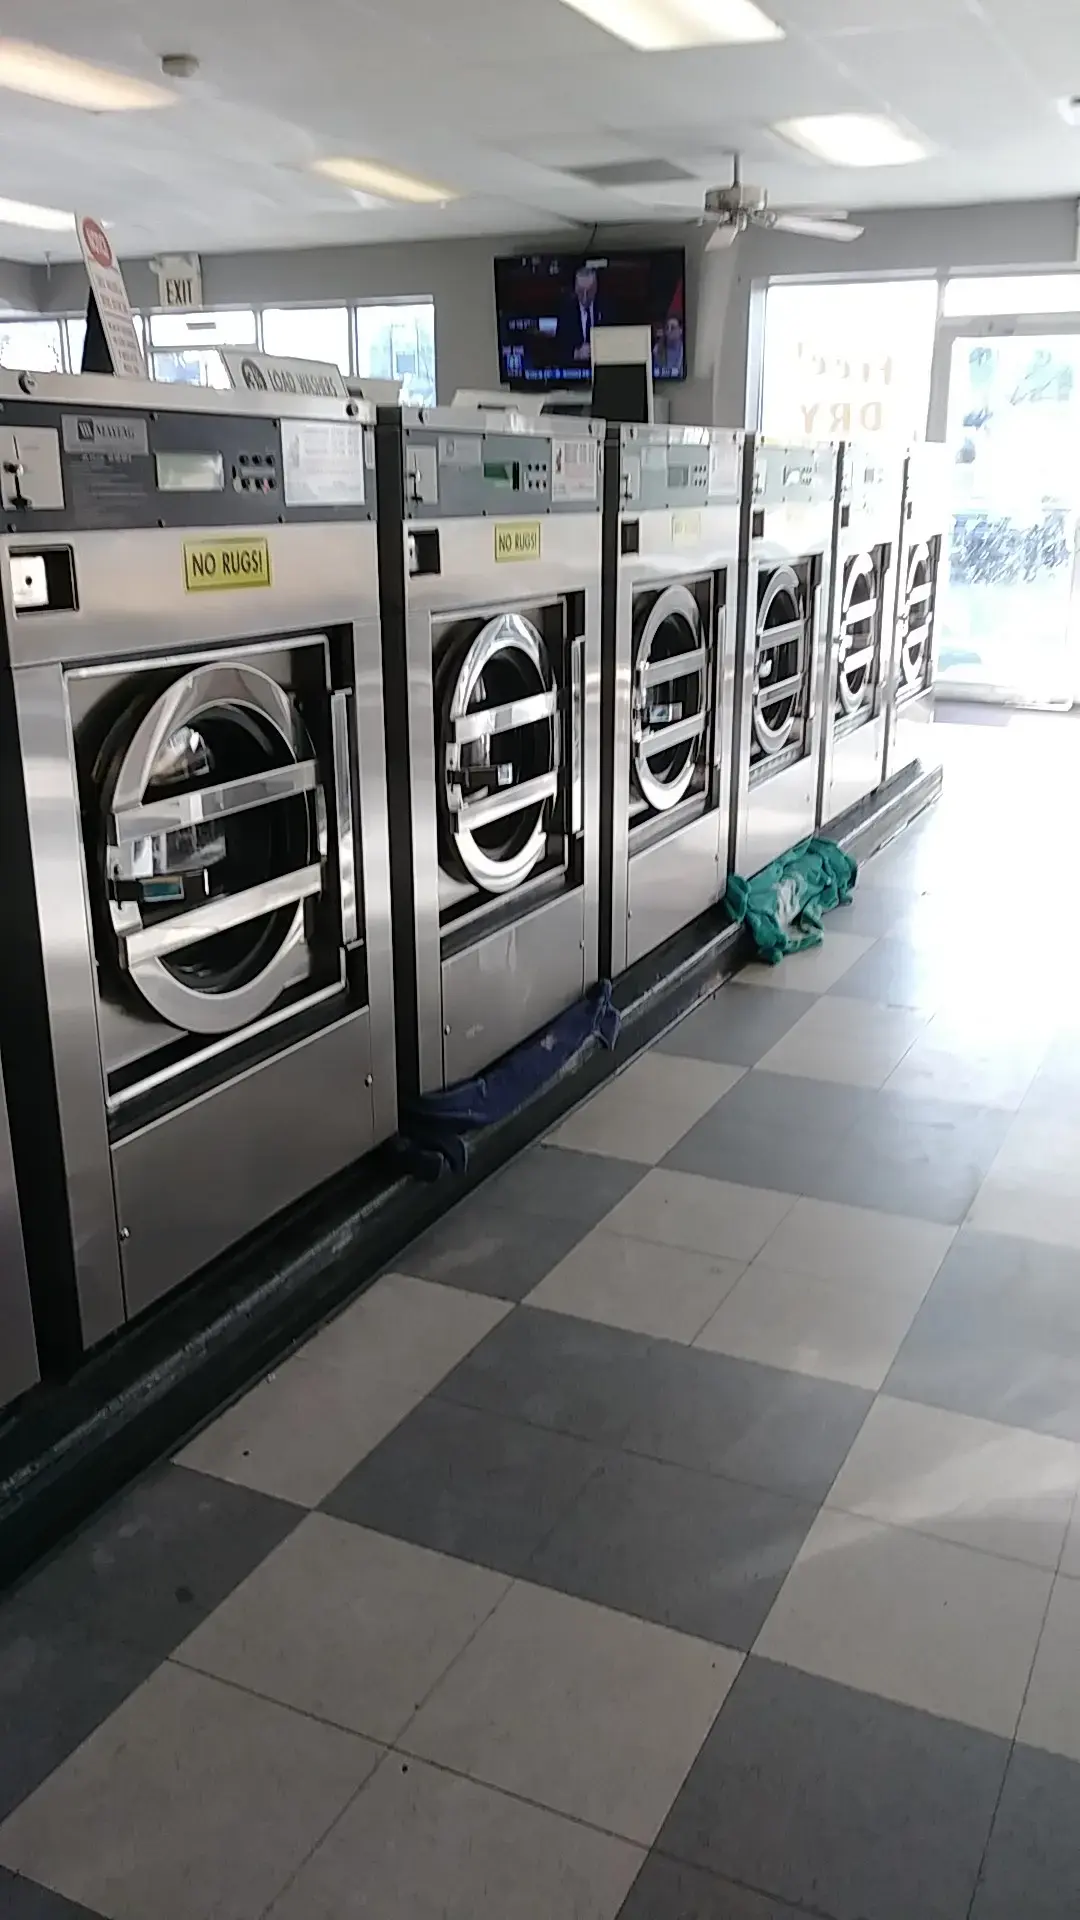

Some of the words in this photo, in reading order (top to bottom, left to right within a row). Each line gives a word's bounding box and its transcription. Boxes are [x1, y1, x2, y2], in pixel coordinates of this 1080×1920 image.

[165, 277, 193, 305] EXIT
[265, 367, 297, 393] LOAD
[296, 372, 338, 398] WASHERS
[498, 531, 512, 552] NO
[515, 531, 537, 552] RUGS!
[192, 551, 216, 577] NO
[222, 549, 263, 576] RUGS!
